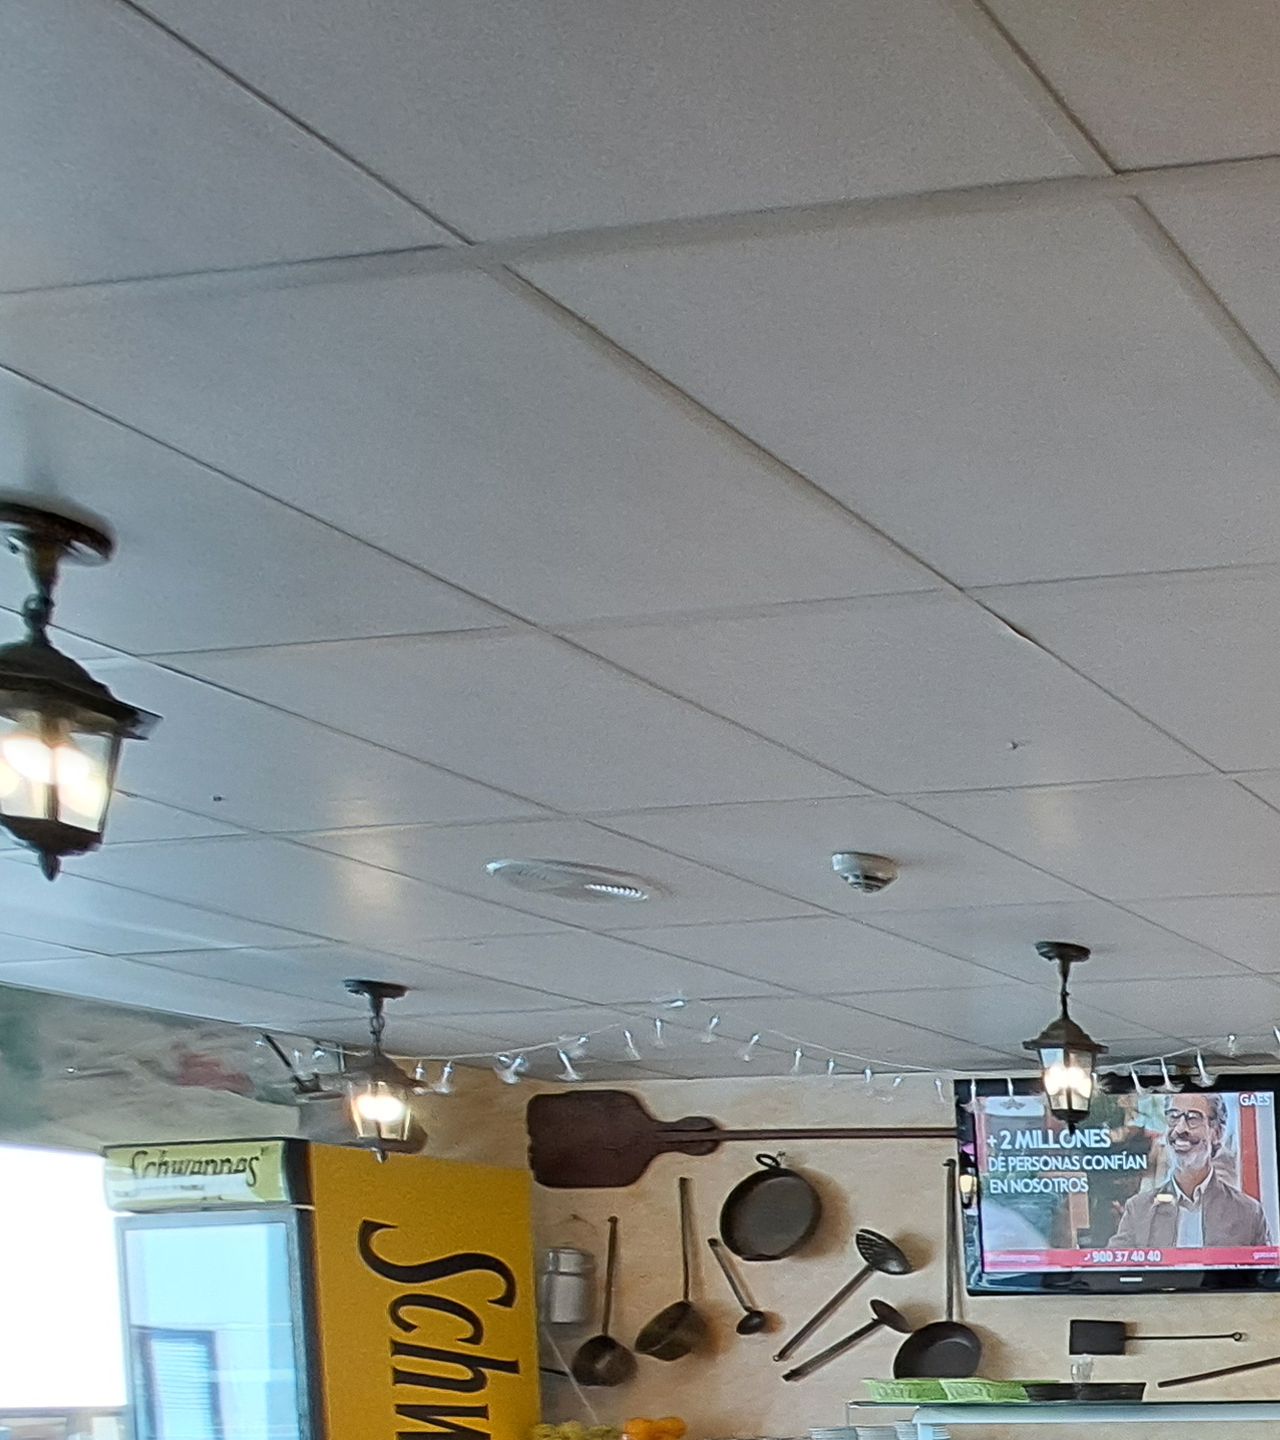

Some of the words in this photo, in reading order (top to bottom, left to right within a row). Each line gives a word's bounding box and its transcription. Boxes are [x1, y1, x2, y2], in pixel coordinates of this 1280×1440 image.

[1239, 1093, 1271, 1106] GAES
[1000, 1130, 1013, 1150] 2
[1015, 1128, 1111, 1149] MILLONES
[988, 1156, 1007, 1172] DE
[1008, 1154, 1081, 1172] PERSONAS
[1082, 1150, 1149, 1171] CONFÍAN
[989, 1179, 1008, 1194] EN
[1010, 1177, 1090, 1194] NOSOTROS
[1091, 1251, 1113, 1263] 900
[1115, 1251, 1130, 1263] 37
[1130, 1251, 1146, 1263] 40
[1146, 1250, 1162, 1263] 40
